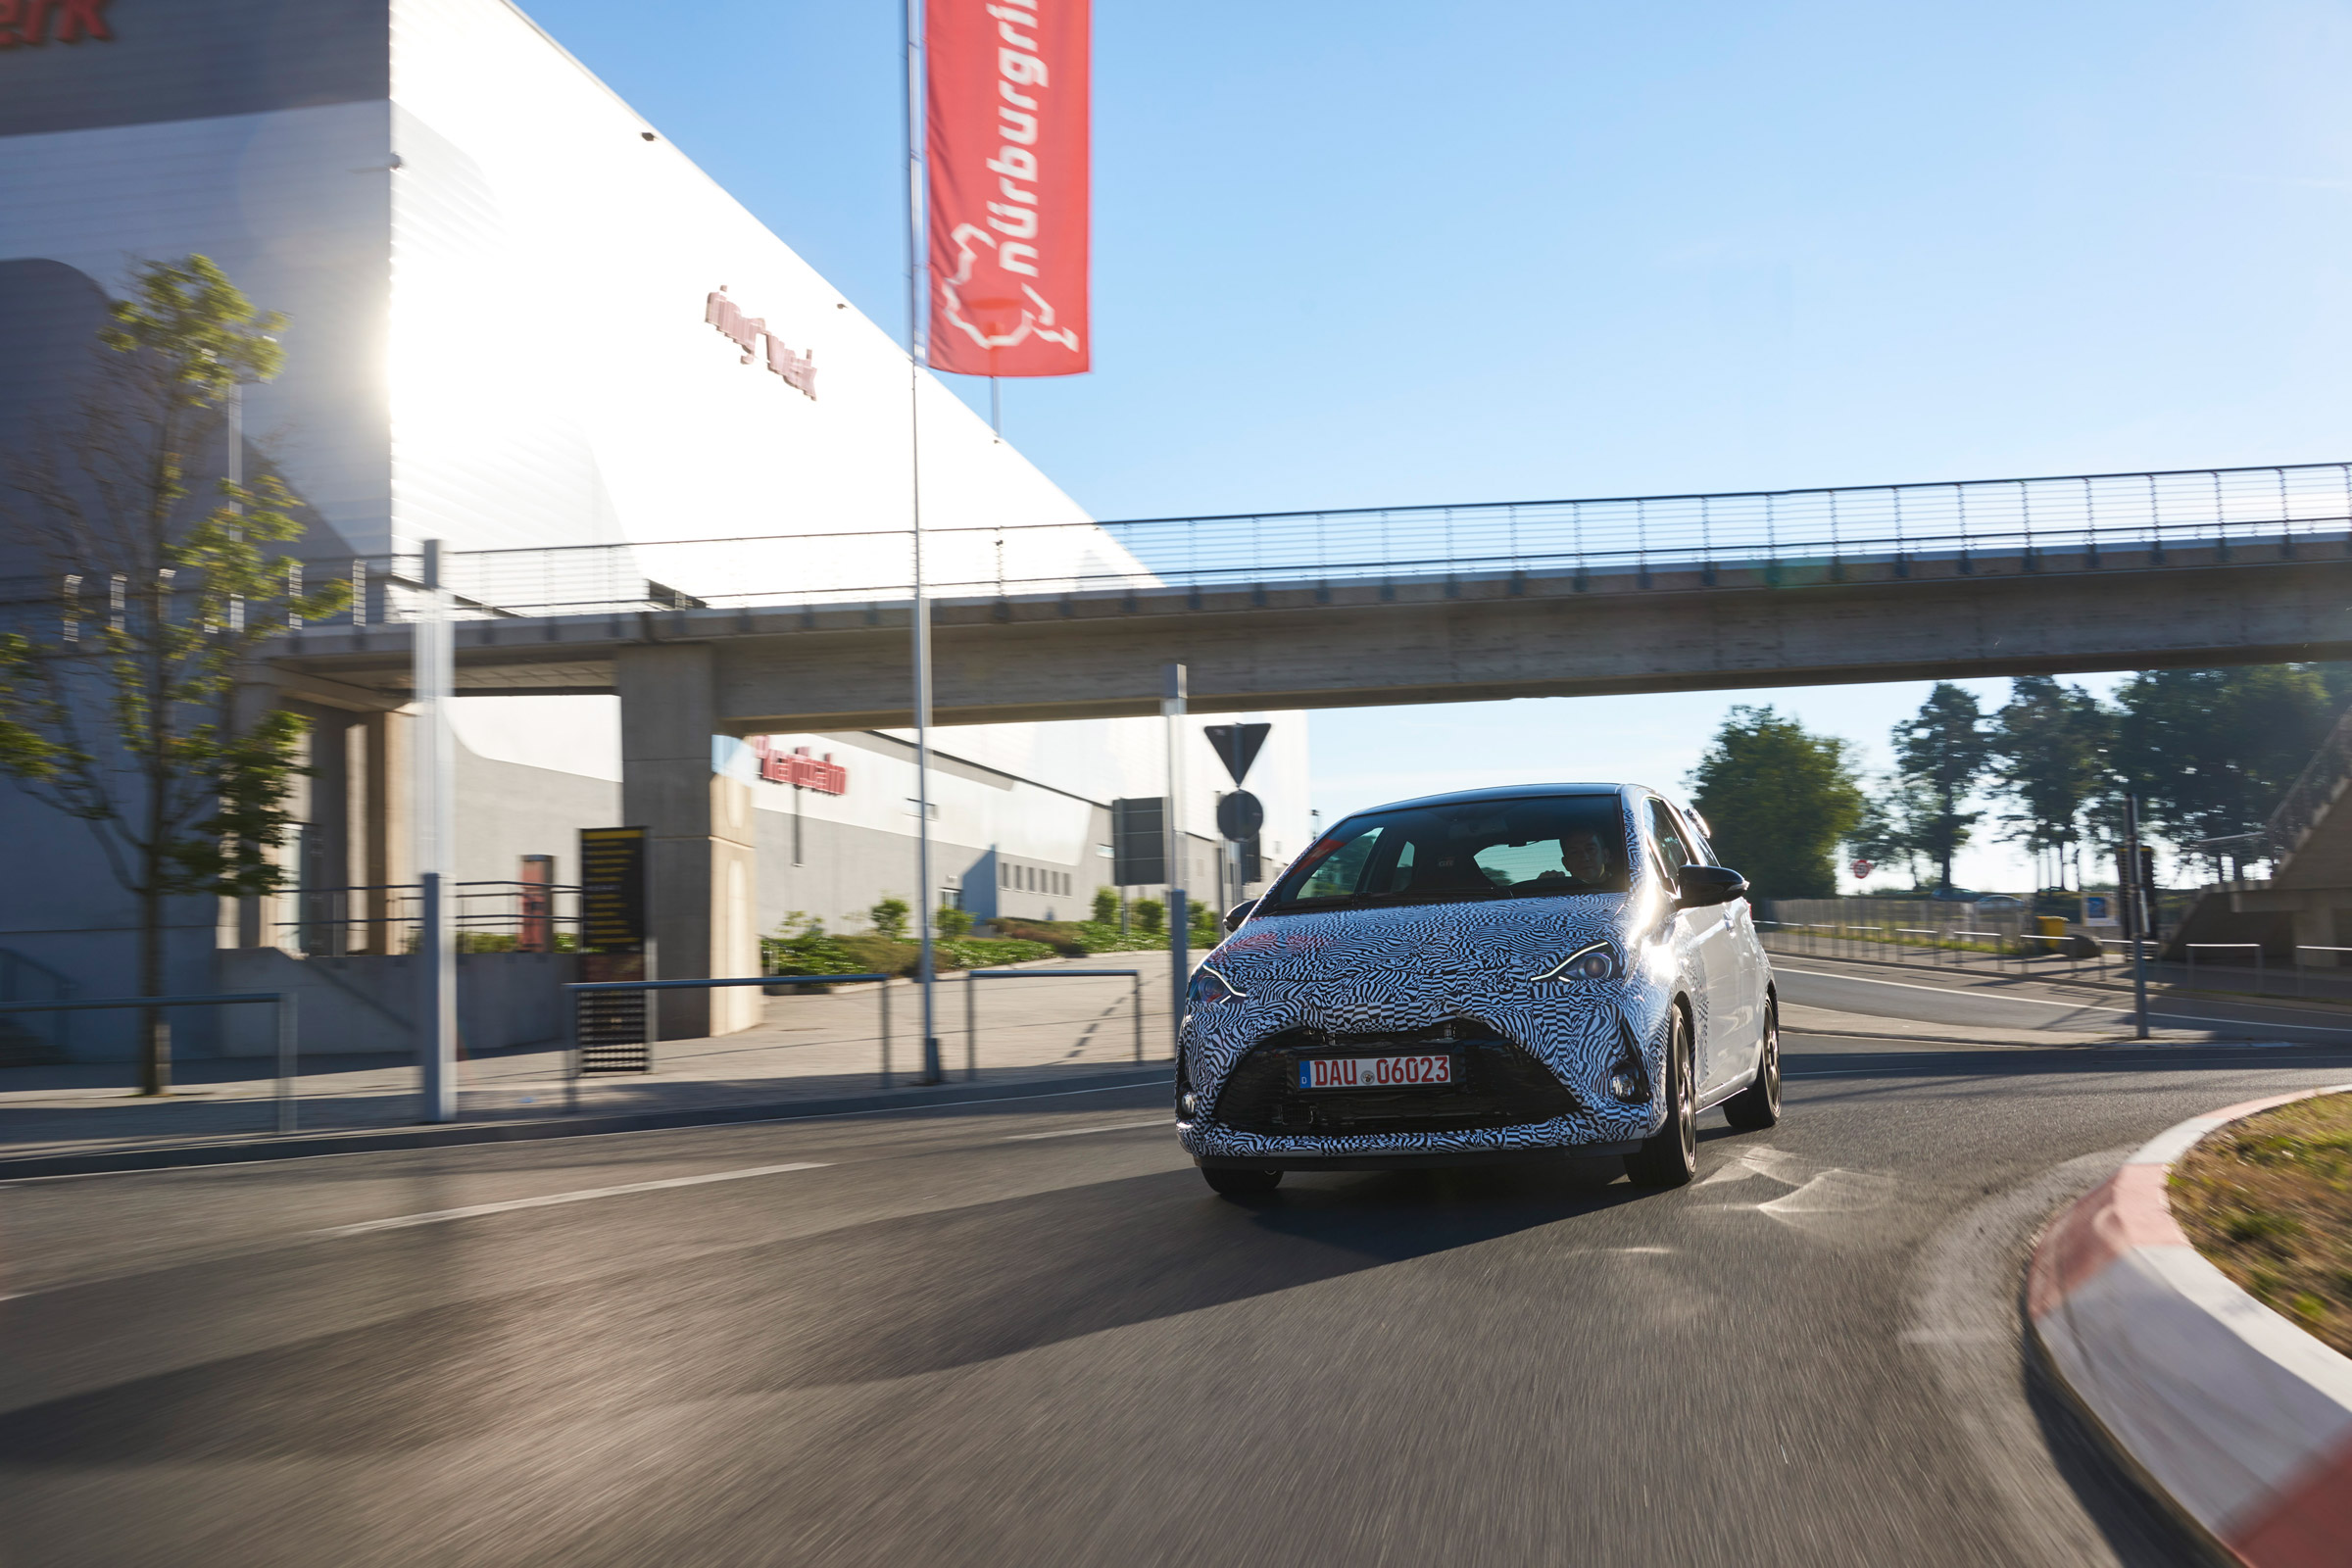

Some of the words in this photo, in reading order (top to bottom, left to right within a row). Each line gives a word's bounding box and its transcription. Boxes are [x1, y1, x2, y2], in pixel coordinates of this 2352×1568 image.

[986, 0, 1049, 277] nürburgri
[1314, 1059, 1357, 1086] DAU
[1376, 1056, 1449, 1085] 06023
